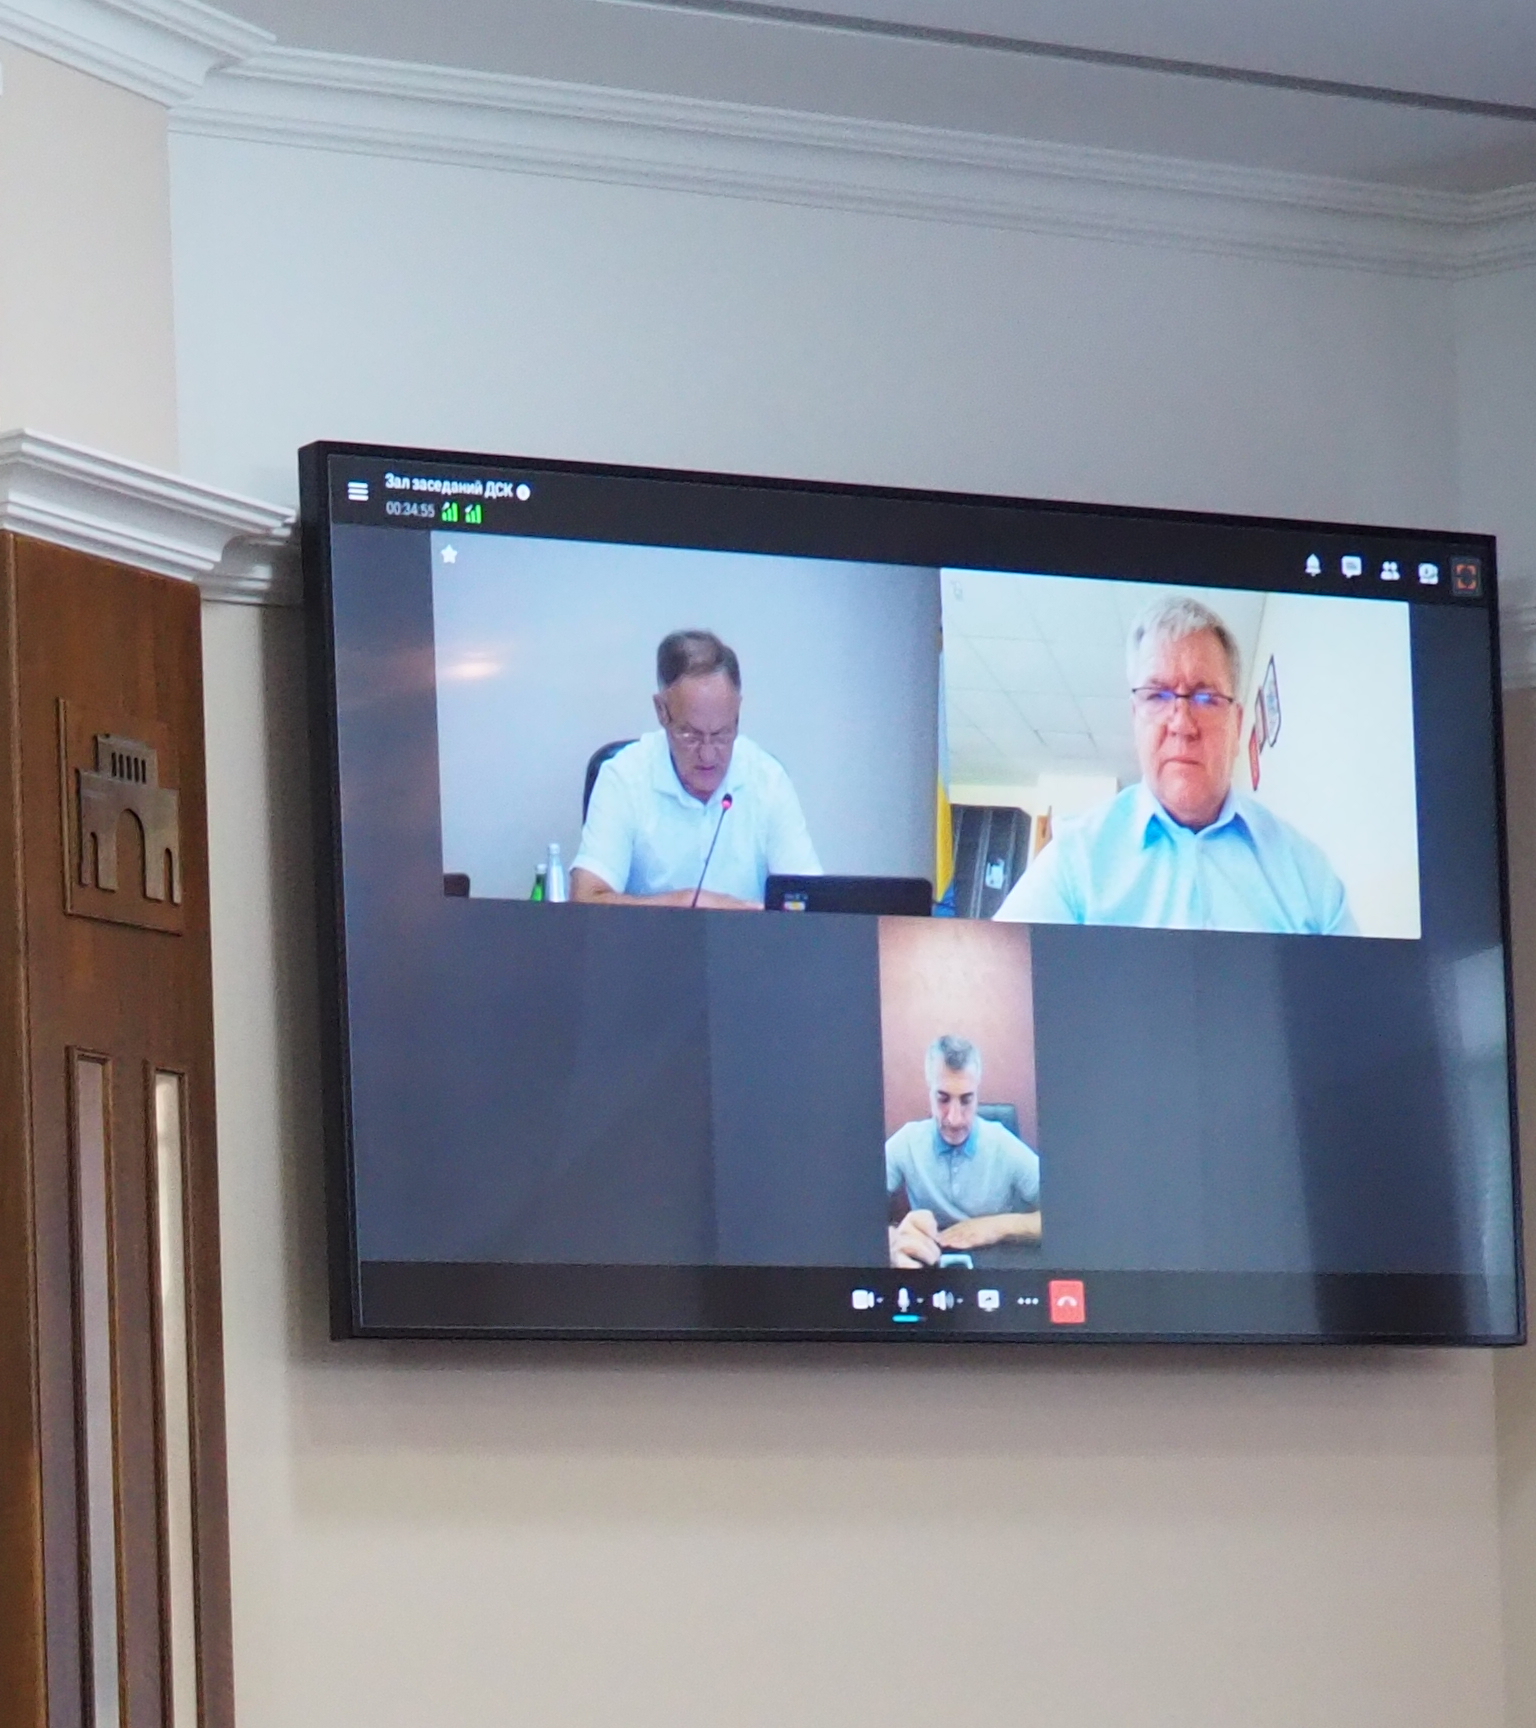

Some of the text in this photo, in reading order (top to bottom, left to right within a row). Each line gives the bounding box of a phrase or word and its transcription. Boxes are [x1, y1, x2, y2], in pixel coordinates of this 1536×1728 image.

[384, 472, 514, 499] Зал заседаний ДСК
